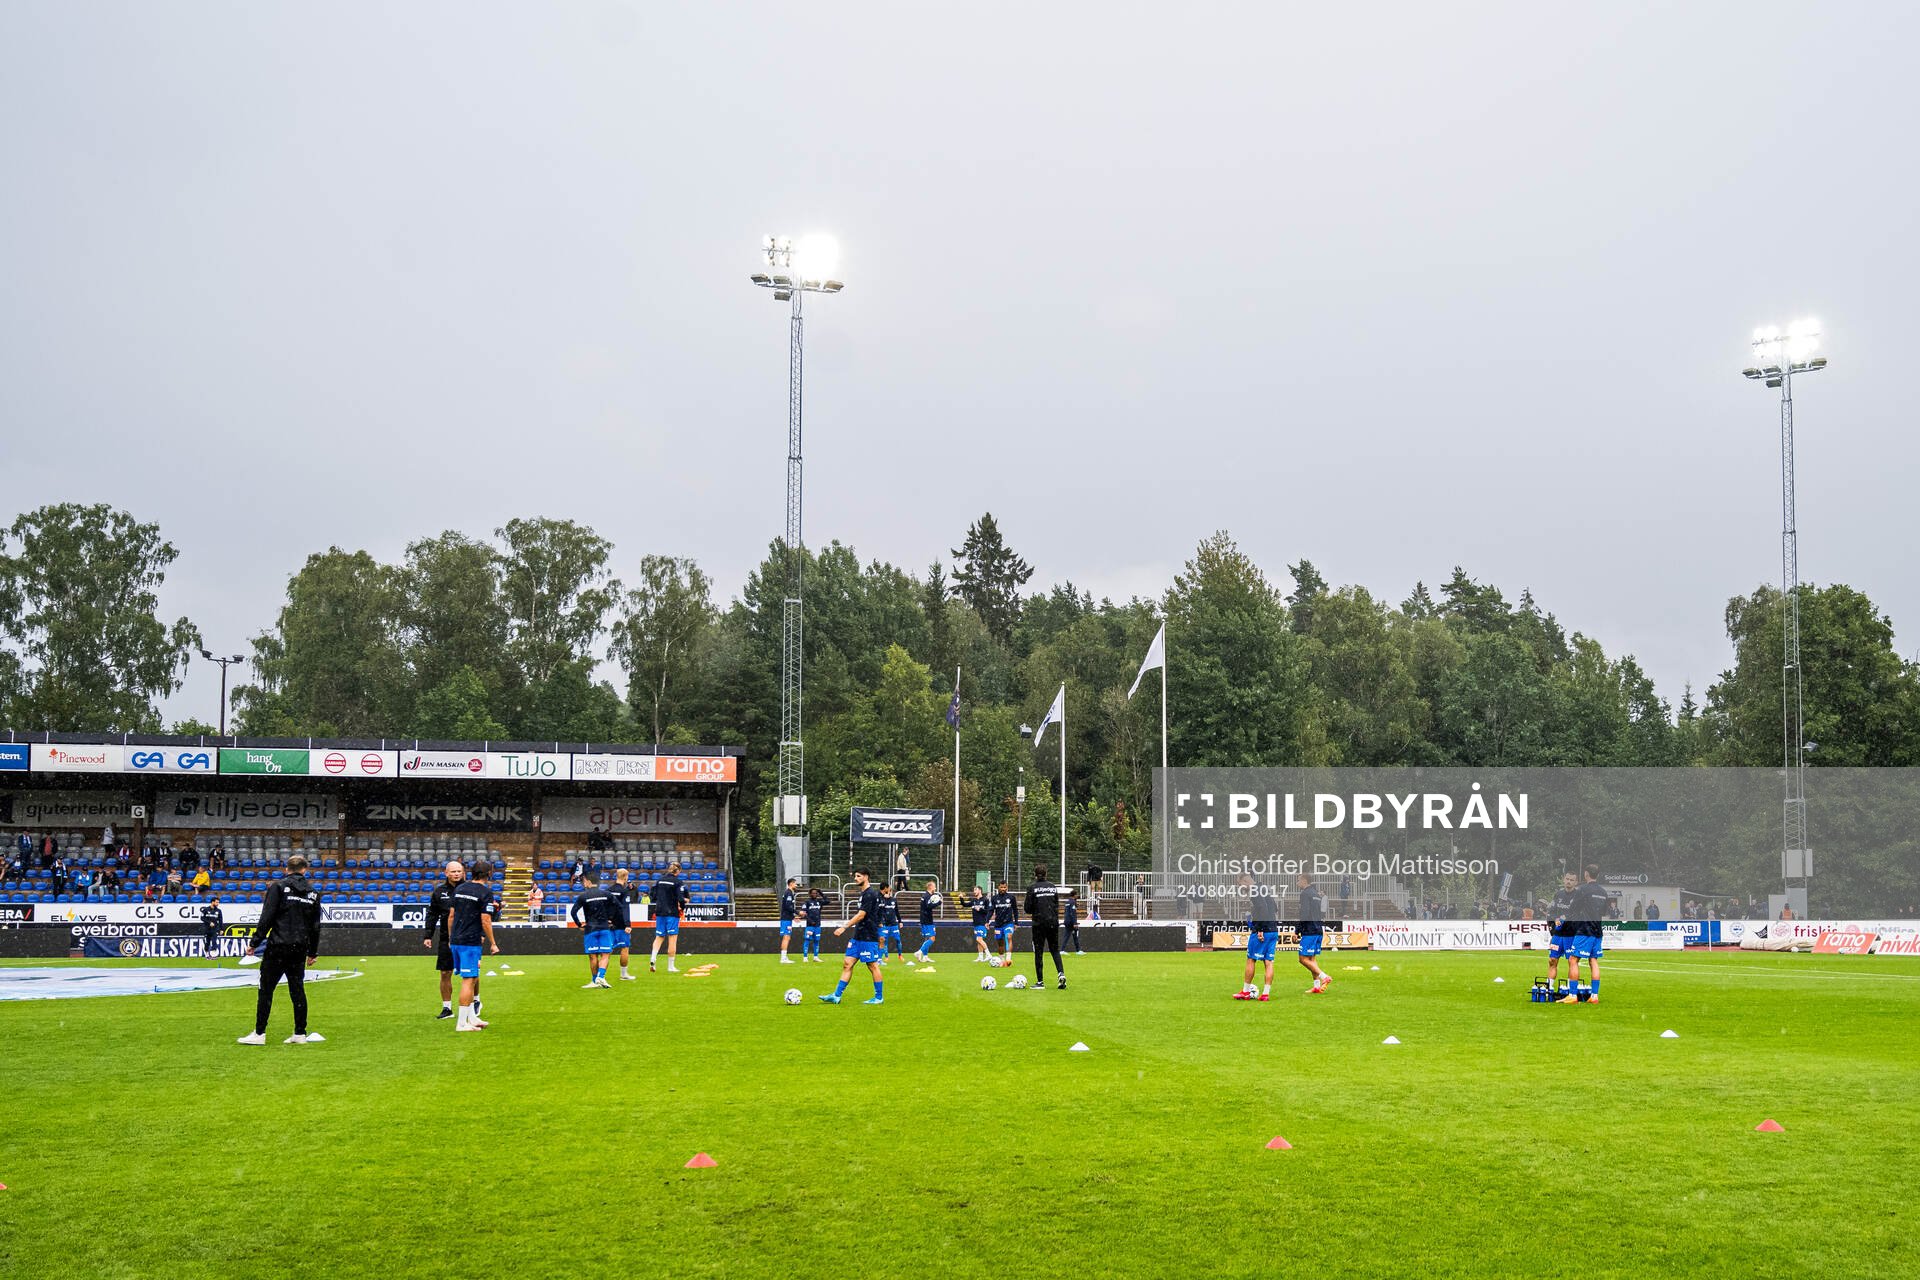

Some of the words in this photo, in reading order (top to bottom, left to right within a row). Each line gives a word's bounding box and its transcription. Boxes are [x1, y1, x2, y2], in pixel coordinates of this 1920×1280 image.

[59, 752, 105, 764] Pinewood
[132, 752, 164, 768] GA
[177, 753, 209, 769] GA
[247, 752, 273, 766] hang
[265, 762, 282, 773] On
[501, 755, 556, 776] TuJo
[585, 767, 609, 775] SMIDE
[666, 759, 725, 773] ramo
[133, 806, 143, 817] G
[366, 805, 523, 822] ZINKTEKNIK
[590, 803, 674, 830] aperit
[863, 821, 932, 831] TROAX
[136, 906, 164, 918] GLS
[321, 907, 377, 920] NORIMA
[72, 924, 158, 936] everbrand
[1509, 924, 1549, 933] HEST
[1670, 925, 1698, 933] MABI
[1379, 933, 1444, 946] NOMINIT
[1453, 933, 1517, 946] NOMINIT
[1824, 933, 1866, 947] ramo
[1879, 934, 1920, 952] nivik
